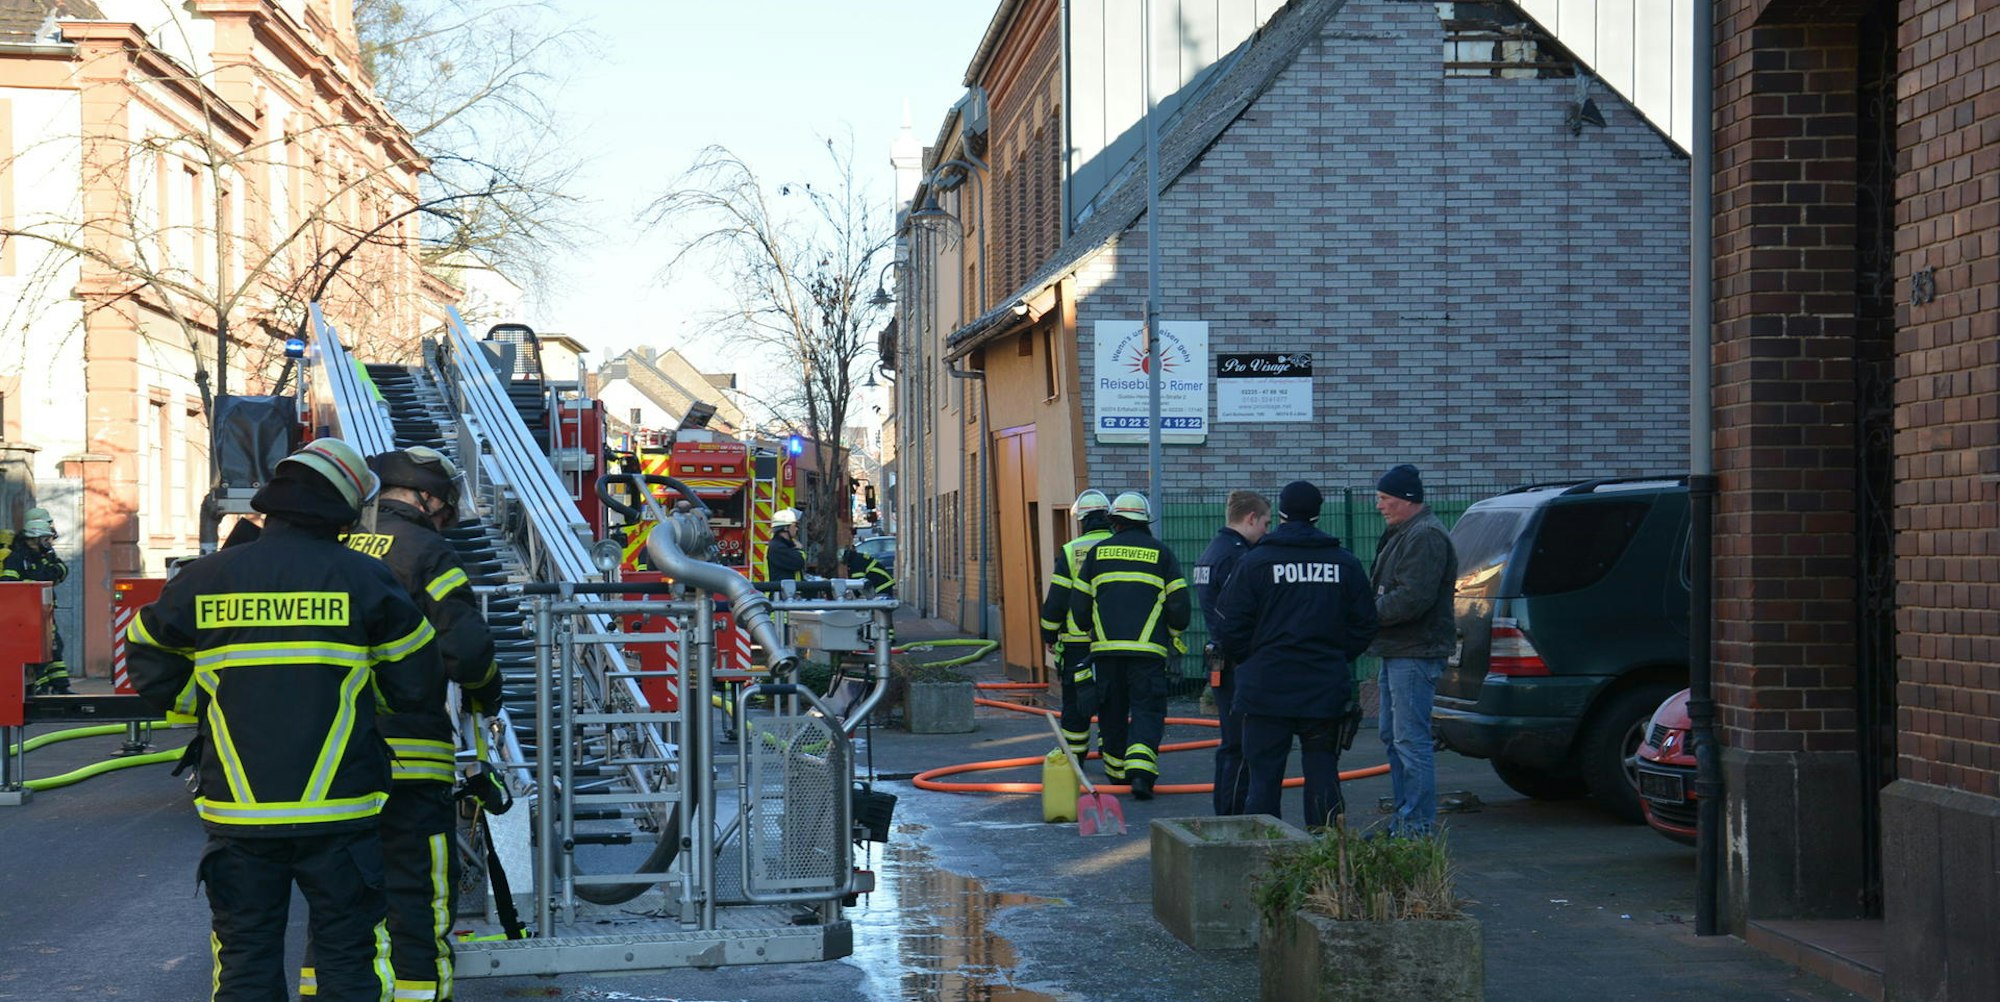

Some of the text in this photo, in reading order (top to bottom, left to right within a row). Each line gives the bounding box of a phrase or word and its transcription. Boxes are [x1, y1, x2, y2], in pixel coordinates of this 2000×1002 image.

[1159, 328, 1180, 345] eisen
[1221, 357, 1291, 375] Pro Visage
[1170, 380, 1203, 391] Römer
[1120, 418, 1126, 427] 0
[1128, 418, 1141, 427] 22
[1164, 418, 1171, 427] 4
[1174, 418, 1186, 427] 12
[1188, 418, 1201, 427] 22
[1098, 547, 1157, 561] FEUERWEHR
[1272, 563, 1340, 583] POLIZEI
[201, 598, 344, 622] FEUERWEHR
